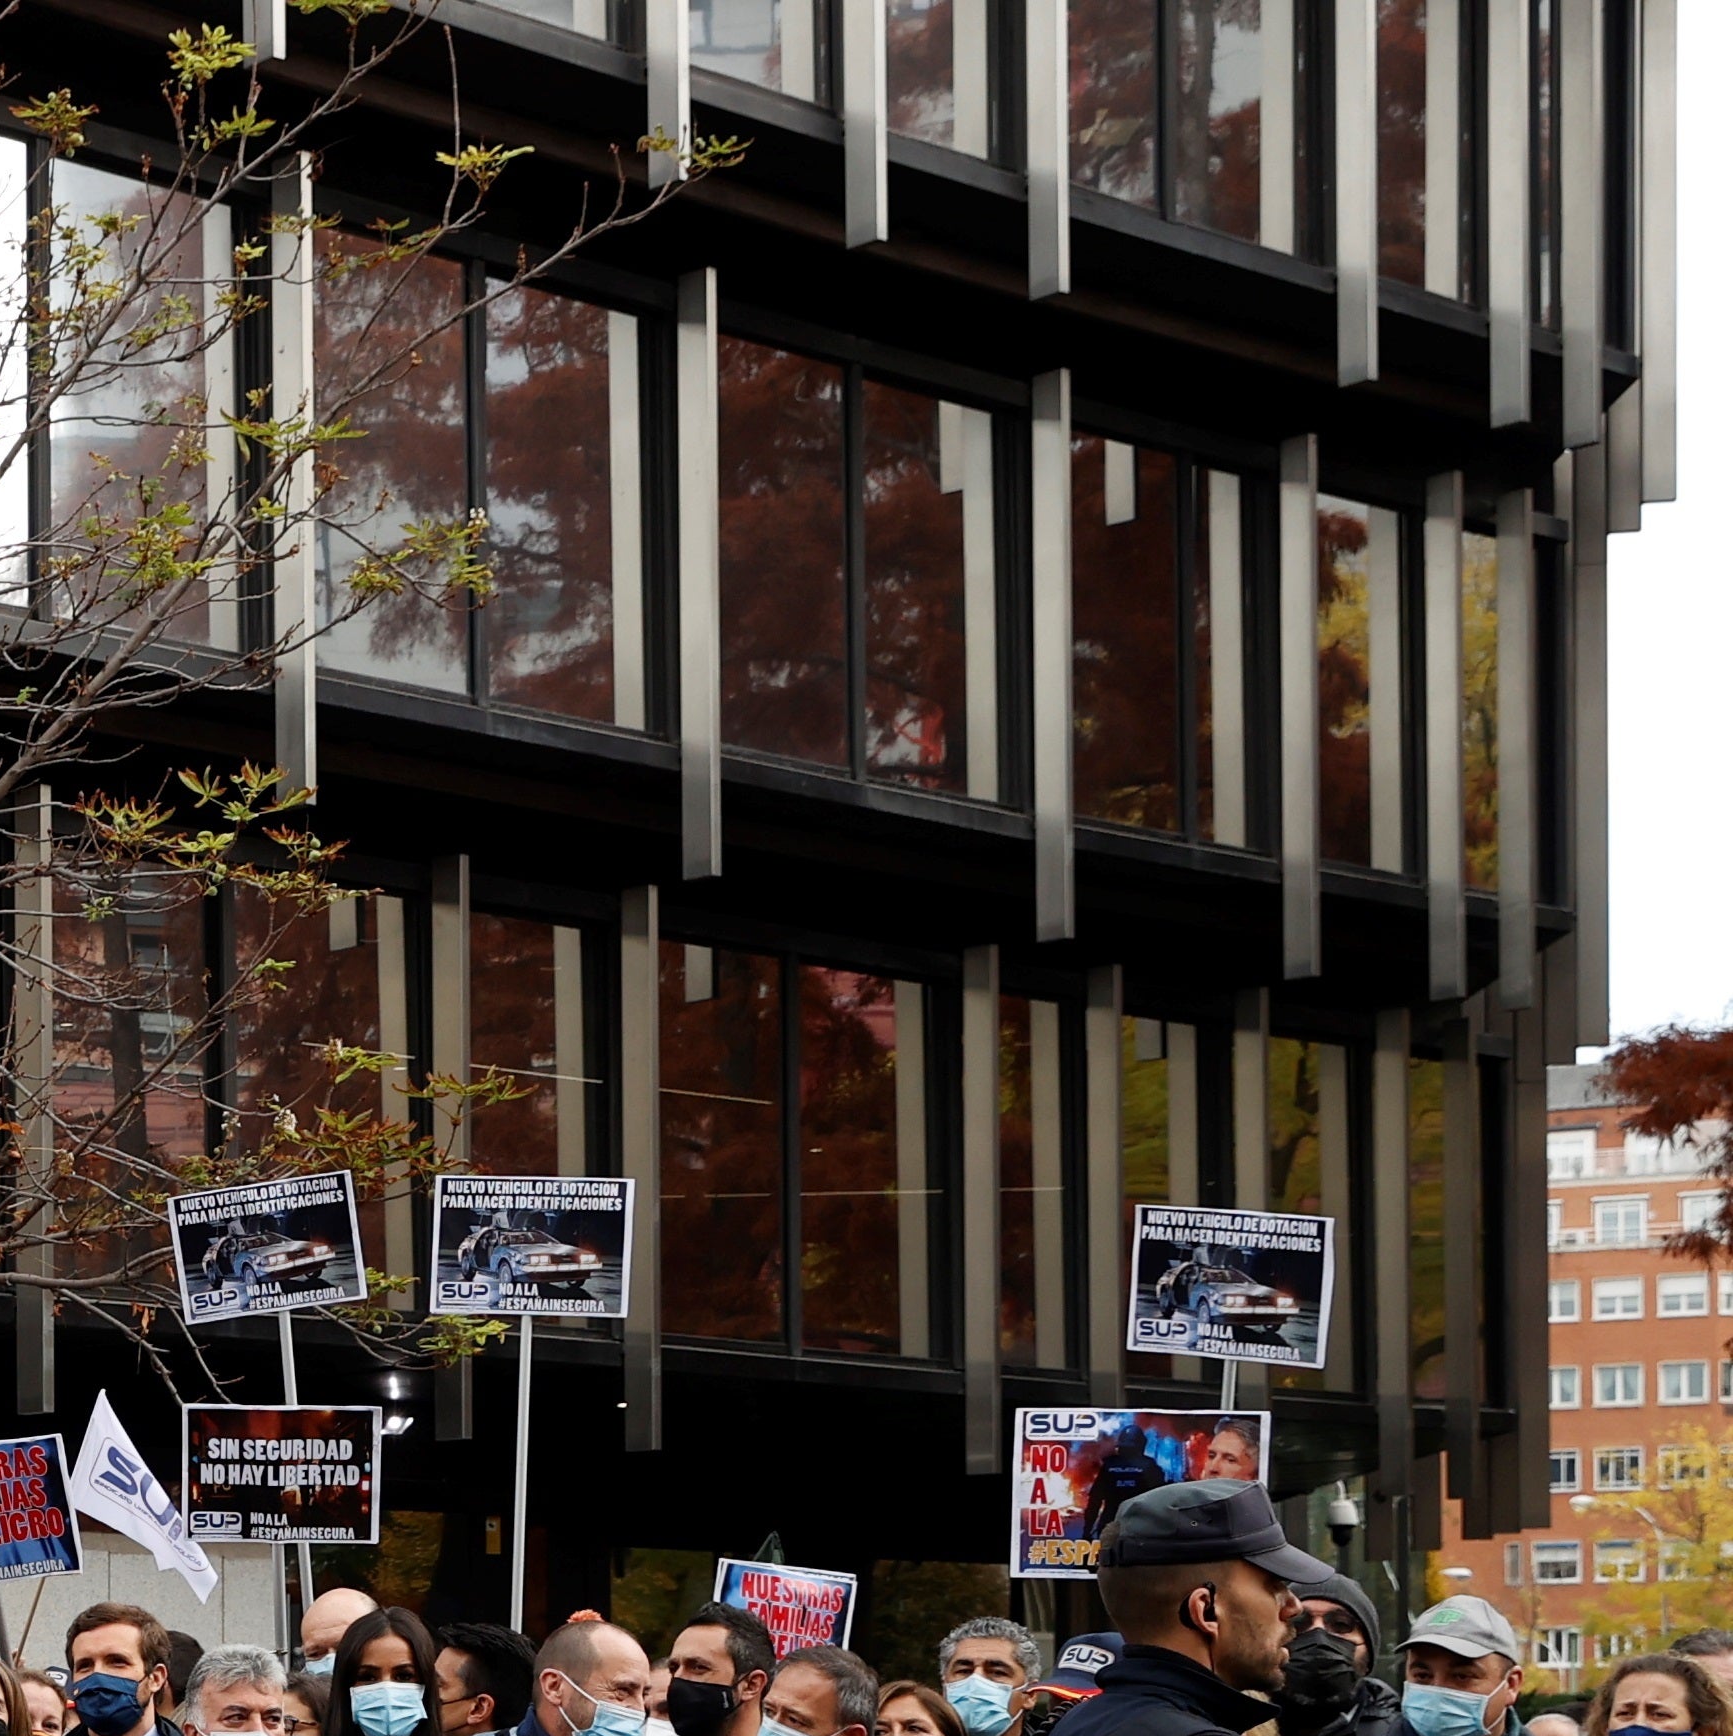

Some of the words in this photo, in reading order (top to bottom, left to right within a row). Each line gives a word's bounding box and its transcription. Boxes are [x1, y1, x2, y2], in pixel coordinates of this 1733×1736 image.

[180, 1195, 216, 1212] NUEVO
[269, 1185, 283, 1199] DE
[447, 1181, 485, 1194] NUEVO
[545, 1183, 562, 1195] DE
[177, 1210, 207, 1226] PARA
[208, 1205, 244, 1222] HACER
[245, 1190, 344, 1216] IDENTIFICACIONES
[442, 1196, 473, 1208] PARA
[475, 1196, 513, 1209] HACER
[515, 1197, 622, 1211] IDENTIFICACIONES
[1147, 1211, 1185, 1226] NUEVO
[1243, 1217, 1258, 1232] DE
[1142, 1226, 1173, 1241] PARA
[1175, 1228, 1213, 1244] HACER
[1215, 1231, 1322, 1252] IDENTIFICACIONES
[193, 1290, 237, 1309] SUP
[442, 1284, 488, 1298] SUP
[1140, 1321, 1186, 1337] SUP
[1030, 1414, 1096, 1433] SUP
[208, 1438, 240, 1459] SIN
[243, 1439, 352, 1460] SEGURIDAD
[1029, 1444, 1067, 1472] NO
[201, 1464, 225, 1484] NO
[228, 1464, 264, 1485] HAY
[267, 1465, 360, 1486] LIBERTAD
[1029, 1477, 1048, 1504] A
[193, 1514, 240, 1528] SUP
[1029, 1509, 1065, 1537] LA
[741, 1572, 845, 1613] NUESTRAS
[1064, 1648, 1109, 1664] SUP
